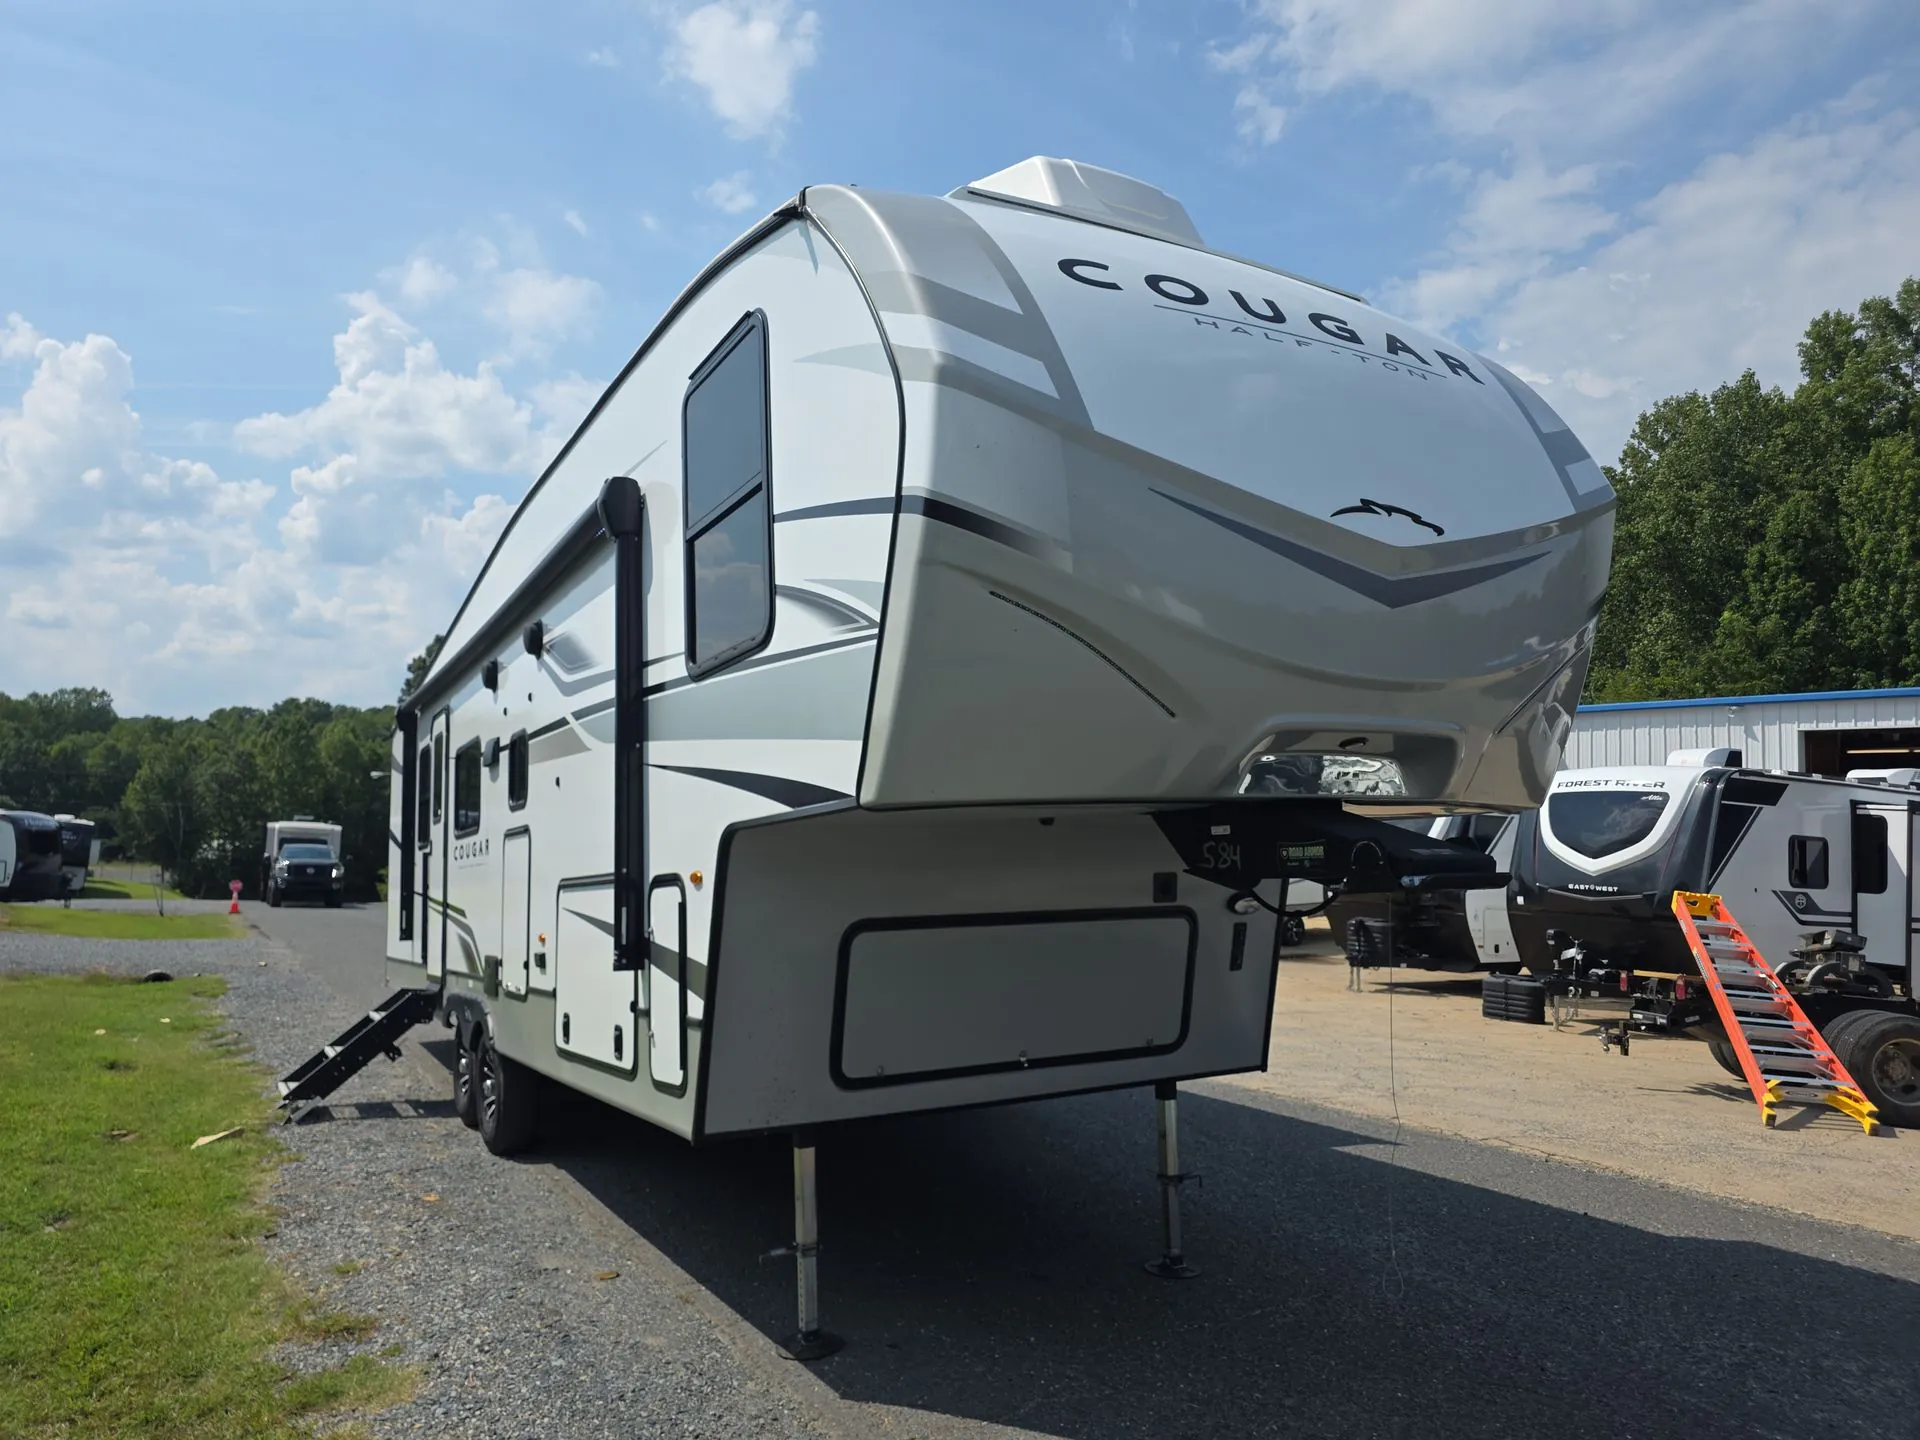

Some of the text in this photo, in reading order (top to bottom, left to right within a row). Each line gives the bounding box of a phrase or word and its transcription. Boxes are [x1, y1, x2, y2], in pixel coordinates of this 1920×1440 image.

[1057, 258, 1485, 385] COUGAR
[1194, 317, 1429, 381] HALF-TON
[1557, 780, 1612, 788] FOREST
[454, 839, 489, 861] COUGAR
[1197, 840, 1241, 870] 584
